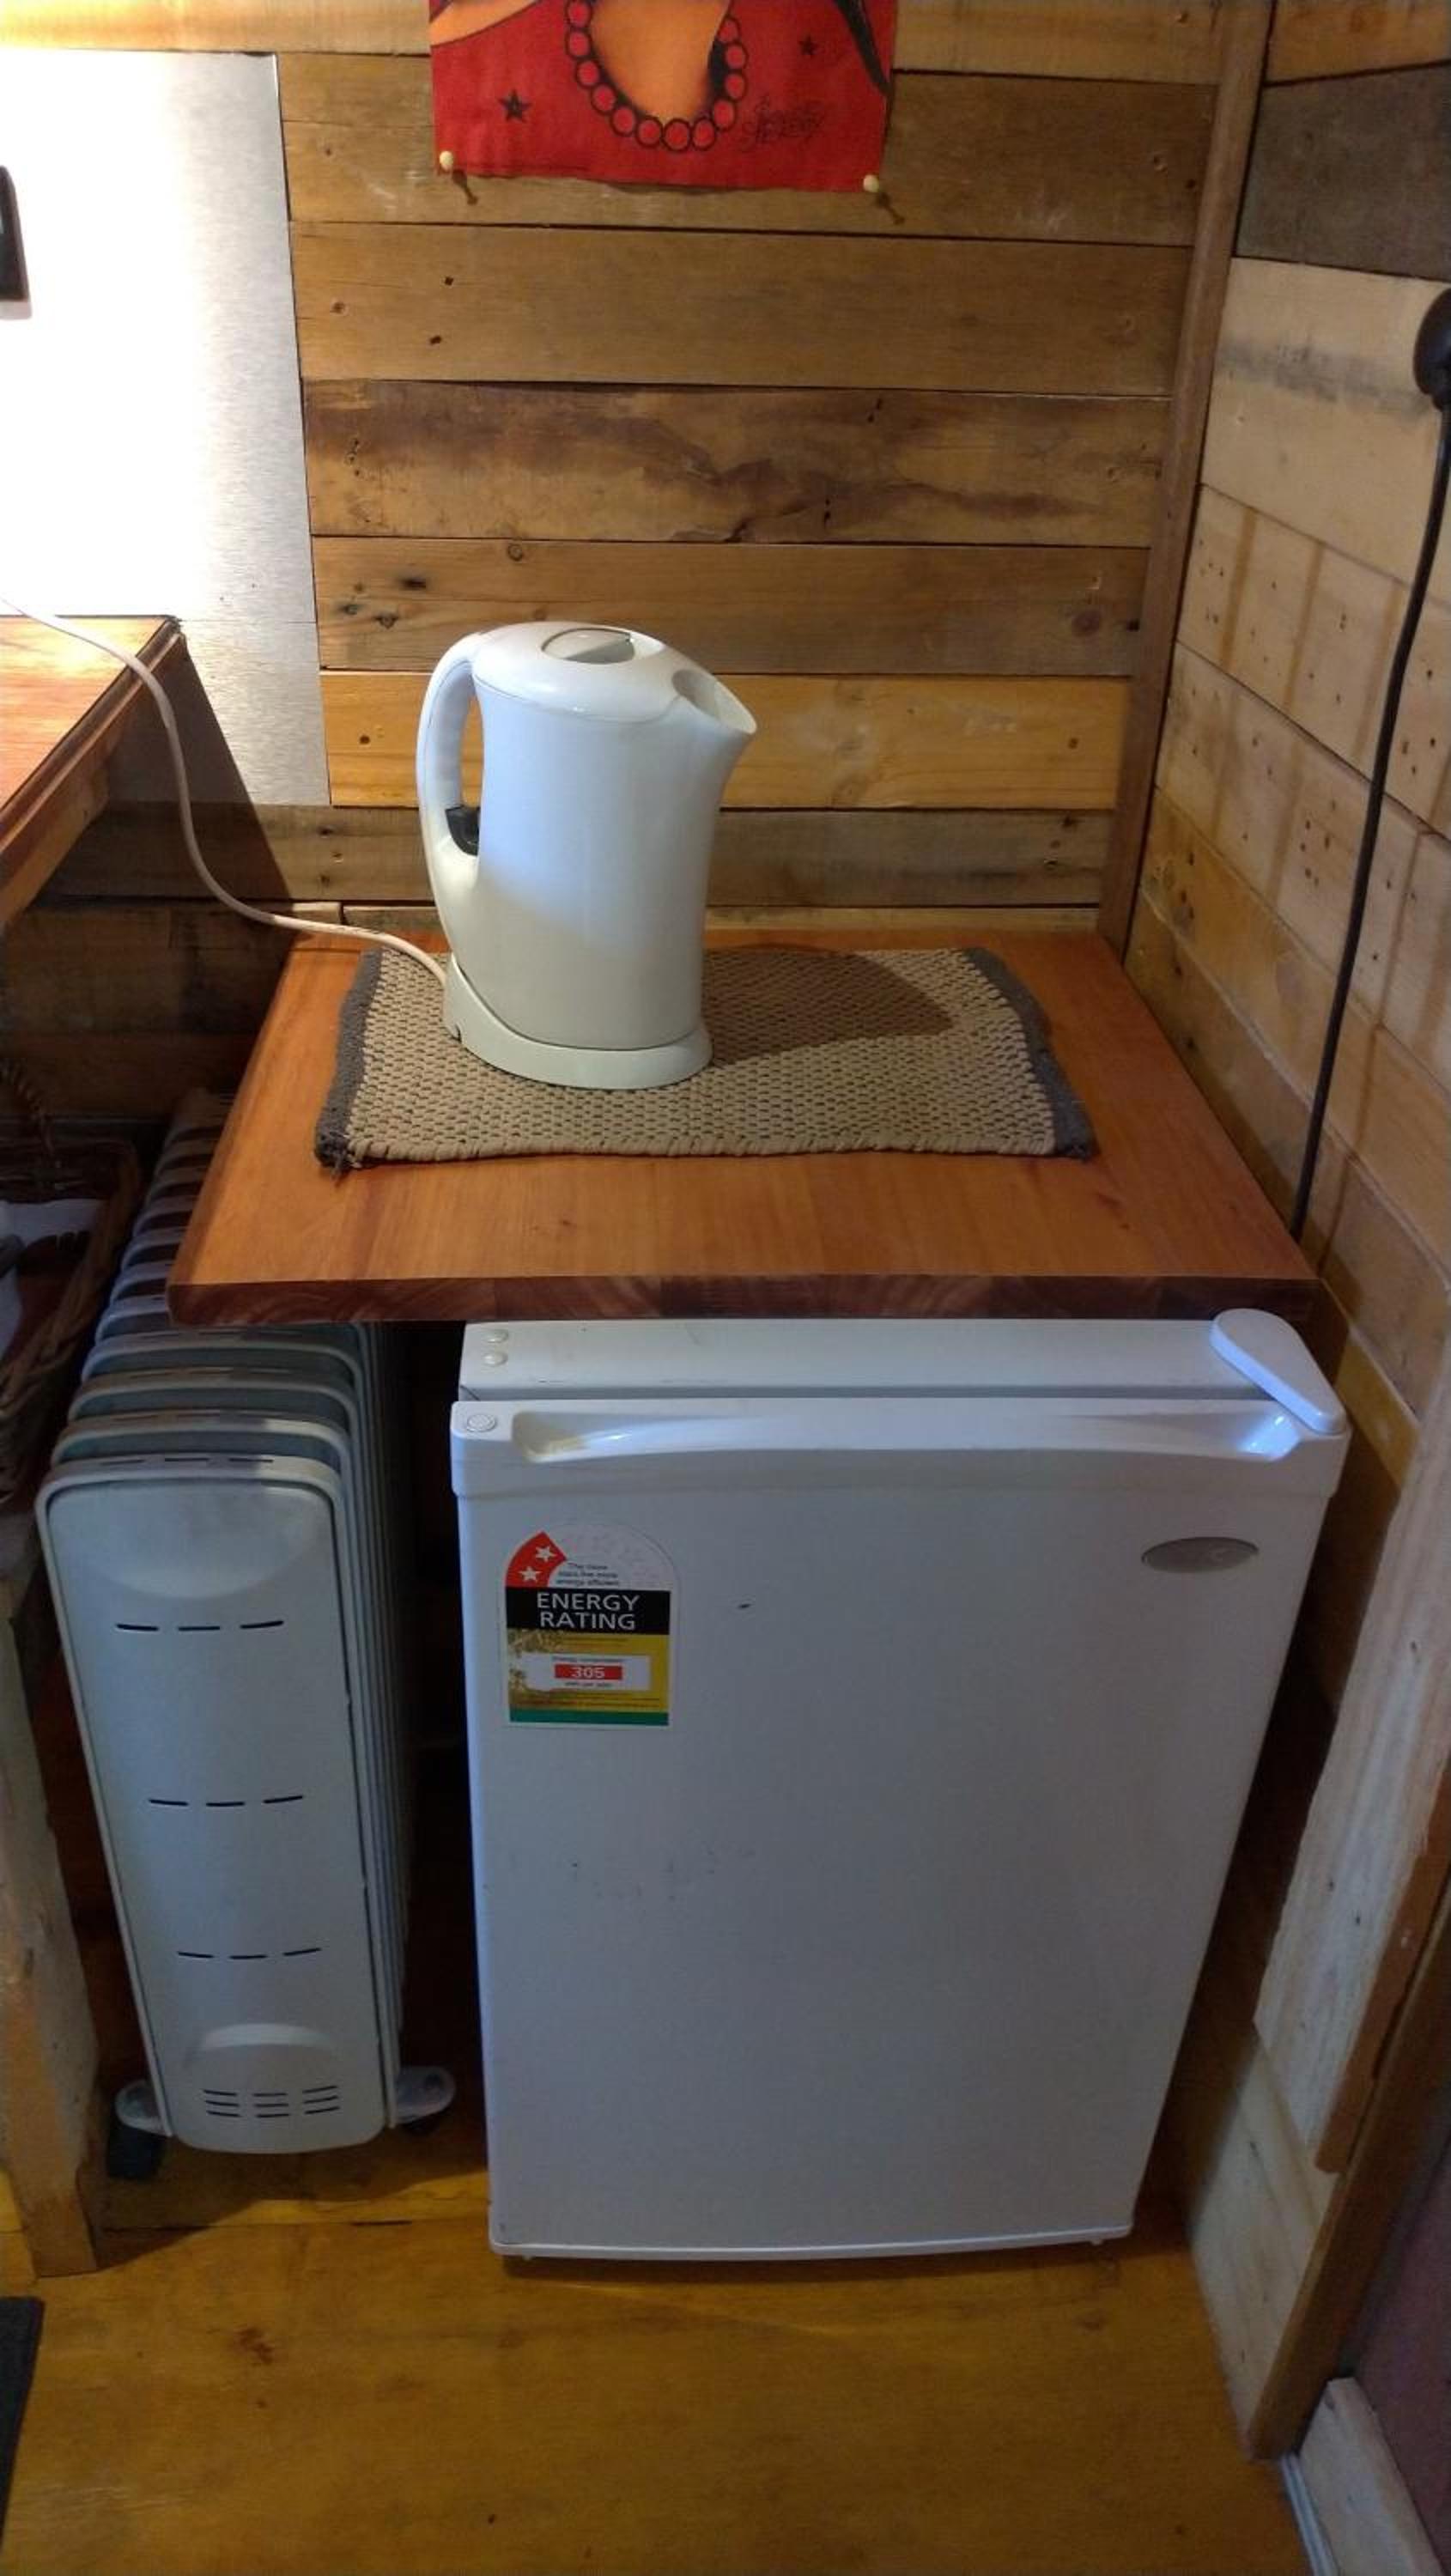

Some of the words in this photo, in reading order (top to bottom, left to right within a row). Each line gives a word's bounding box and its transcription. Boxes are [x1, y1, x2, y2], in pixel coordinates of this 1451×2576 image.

[536, 1592, 640, 1611] ENERGY
[539, 1612, 635, 1631] RATING
[571, 1666, 605, 1680] 305
